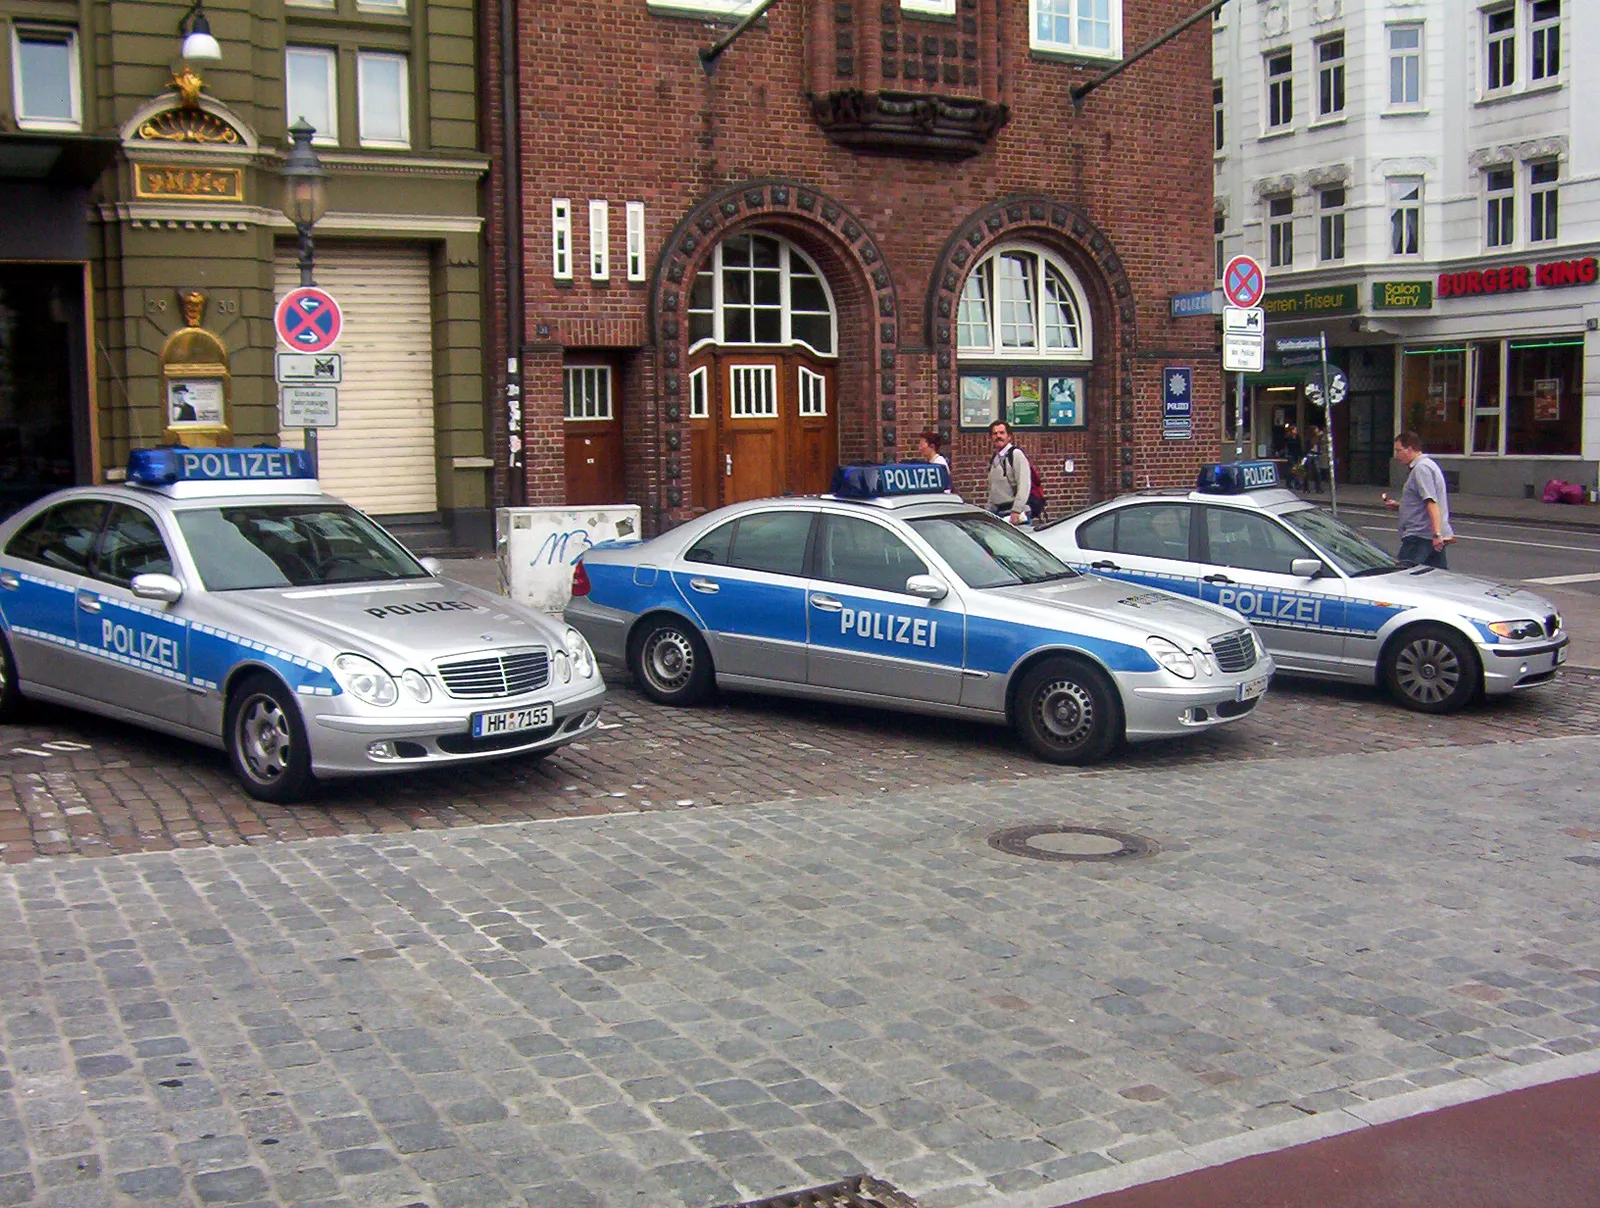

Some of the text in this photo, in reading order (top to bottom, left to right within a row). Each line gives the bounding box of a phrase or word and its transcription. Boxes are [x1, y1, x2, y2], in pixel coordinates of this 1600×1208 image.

[1385, 282, 1421, 295] Salon
[1438, 257, 1597, 296] BURGER KING
[217, 299, 237, 313] 30
[1304, 293, 1344, 310] Friseur
[1384, 293, 1419, 306] Harry
[183, 453, 292, 477] POLIZEI
[1243, 465, 1276, 487] POLIZEI
[884, 467, 942, 491] POLIZEI
[363, 600, 480, 619] POLIZEI
[1218, 588, 1322, 623] POLIZEI
[840, 607, 939, 648] POLIZEI
[102, 617, 179, 670] POLIZEI
[487, 707, 549, 733] HH 7155
